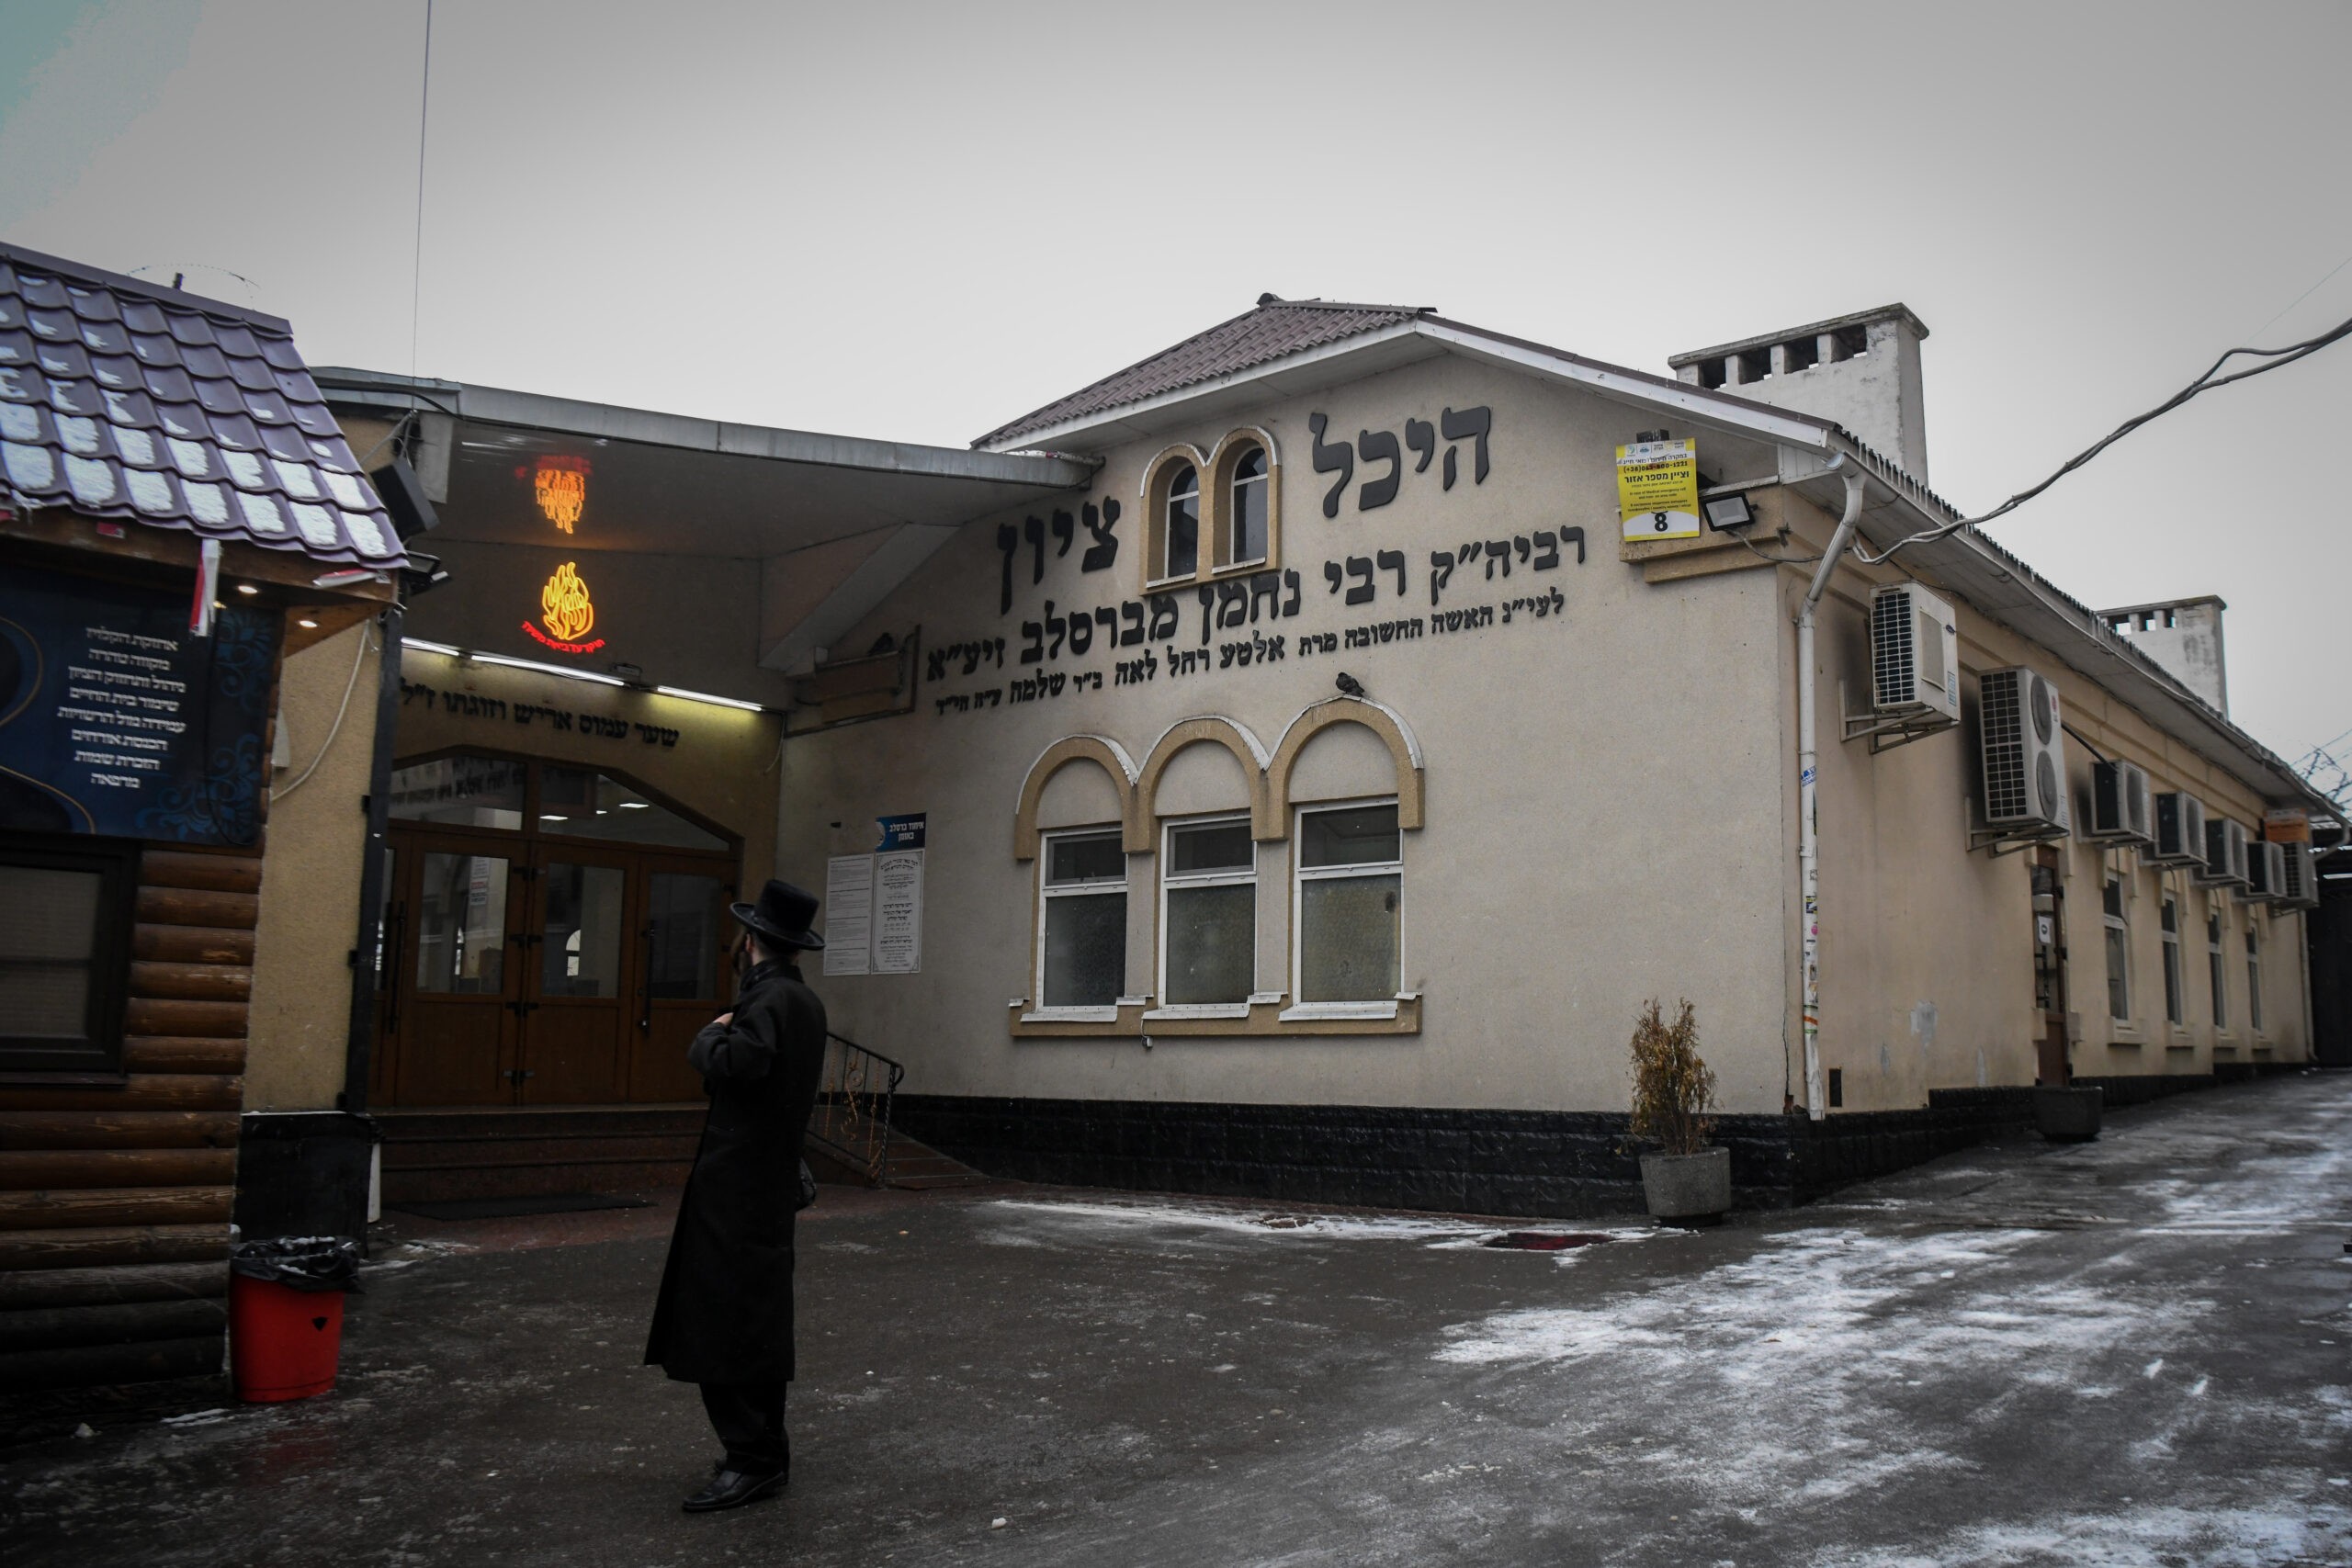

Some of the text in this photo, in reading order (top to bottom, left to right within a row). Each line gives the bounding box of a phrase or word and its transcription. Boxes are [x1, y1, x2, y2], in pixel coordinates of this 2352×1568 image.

[1624, 471, 1690, 483] וציין מספר אזור
[997, 404, 1491, 615] היכל ציון
[1655, 512, 1668, 532] 8
[1324, 549, 1407, 605] רבי
[1198, 569, 1301, 643] נחמן
[1430, 604, 1494, 634] האשה
[1020, 593, 1179, 664] מברסלב
[1344, 617, 1423, 649] החשובה
[1219, 630, 1284, 670] אלטע
[1298, 630, 1338, 657] מרת
[1114, 649, 1158, 685] לאה
[1167, 644, 1210, 678] רחל
[69, 686, 111, 703] החיים
[111, 692, 138, 706] בית
[1010, 667, 1066, 705] שלמה
[115, 709, 141, 728] מול
[579, 714, 628, 739] עמוס
[71, 728, 169, 751] הכנסת אורחים
[634, 722, 680, 748] שער
[74, 749, 115, 765] שמות
[90, 772, 141, 789] מרפאה
[888, 823, 908, 832] ברסלב
